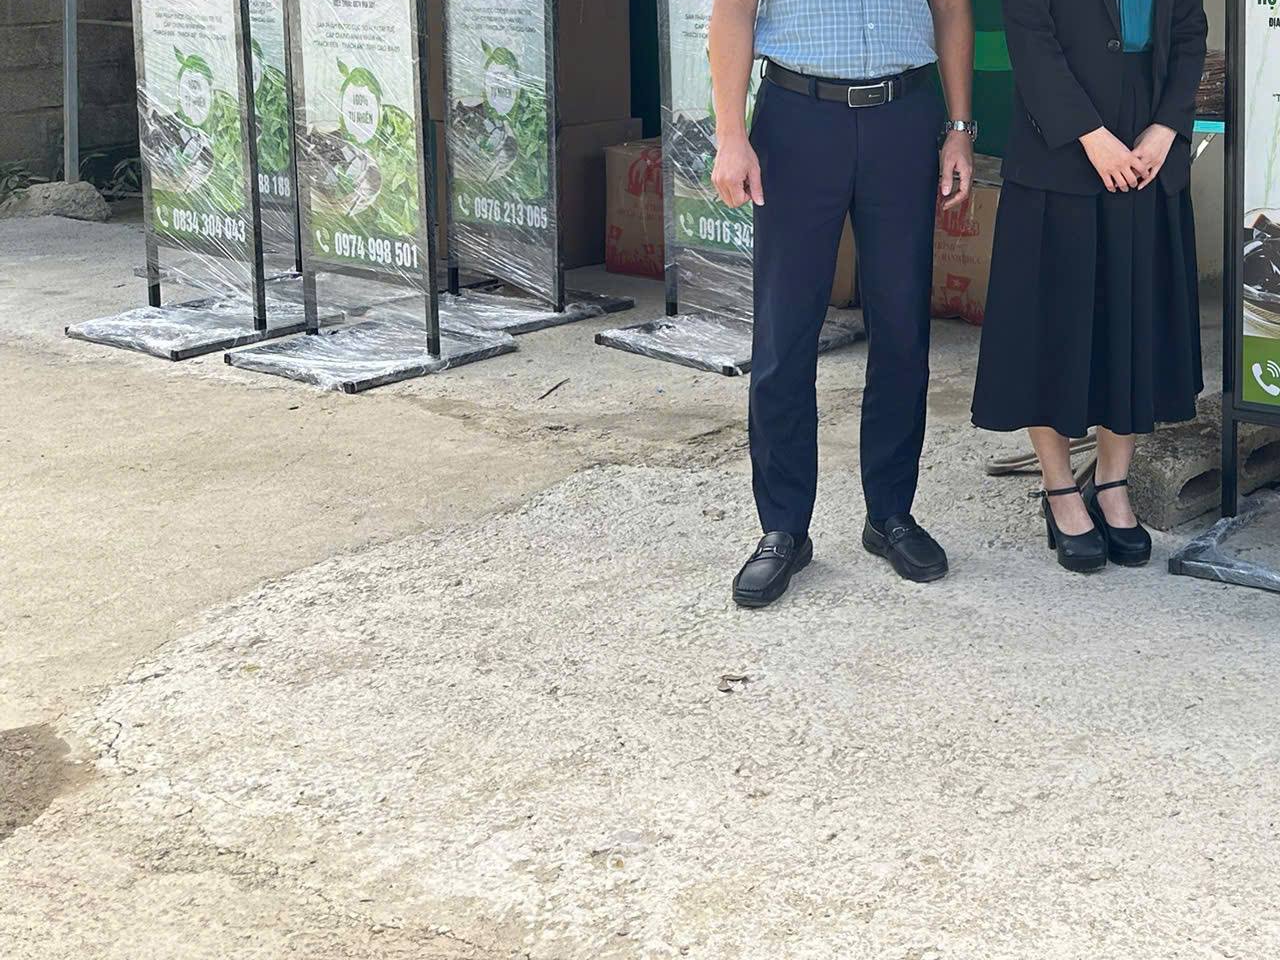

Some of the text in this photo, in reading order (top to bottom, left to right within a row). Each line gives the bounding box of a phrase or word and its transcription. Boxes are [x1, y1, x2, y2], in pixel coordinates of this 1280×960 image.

[1269, 17, 1280, 29] ĐỊA
[474, 196, 548, 229] 0976 213 065
[699, 216, 730, 244] 0916
[335, 231, 418, 269] 0974 998 501
